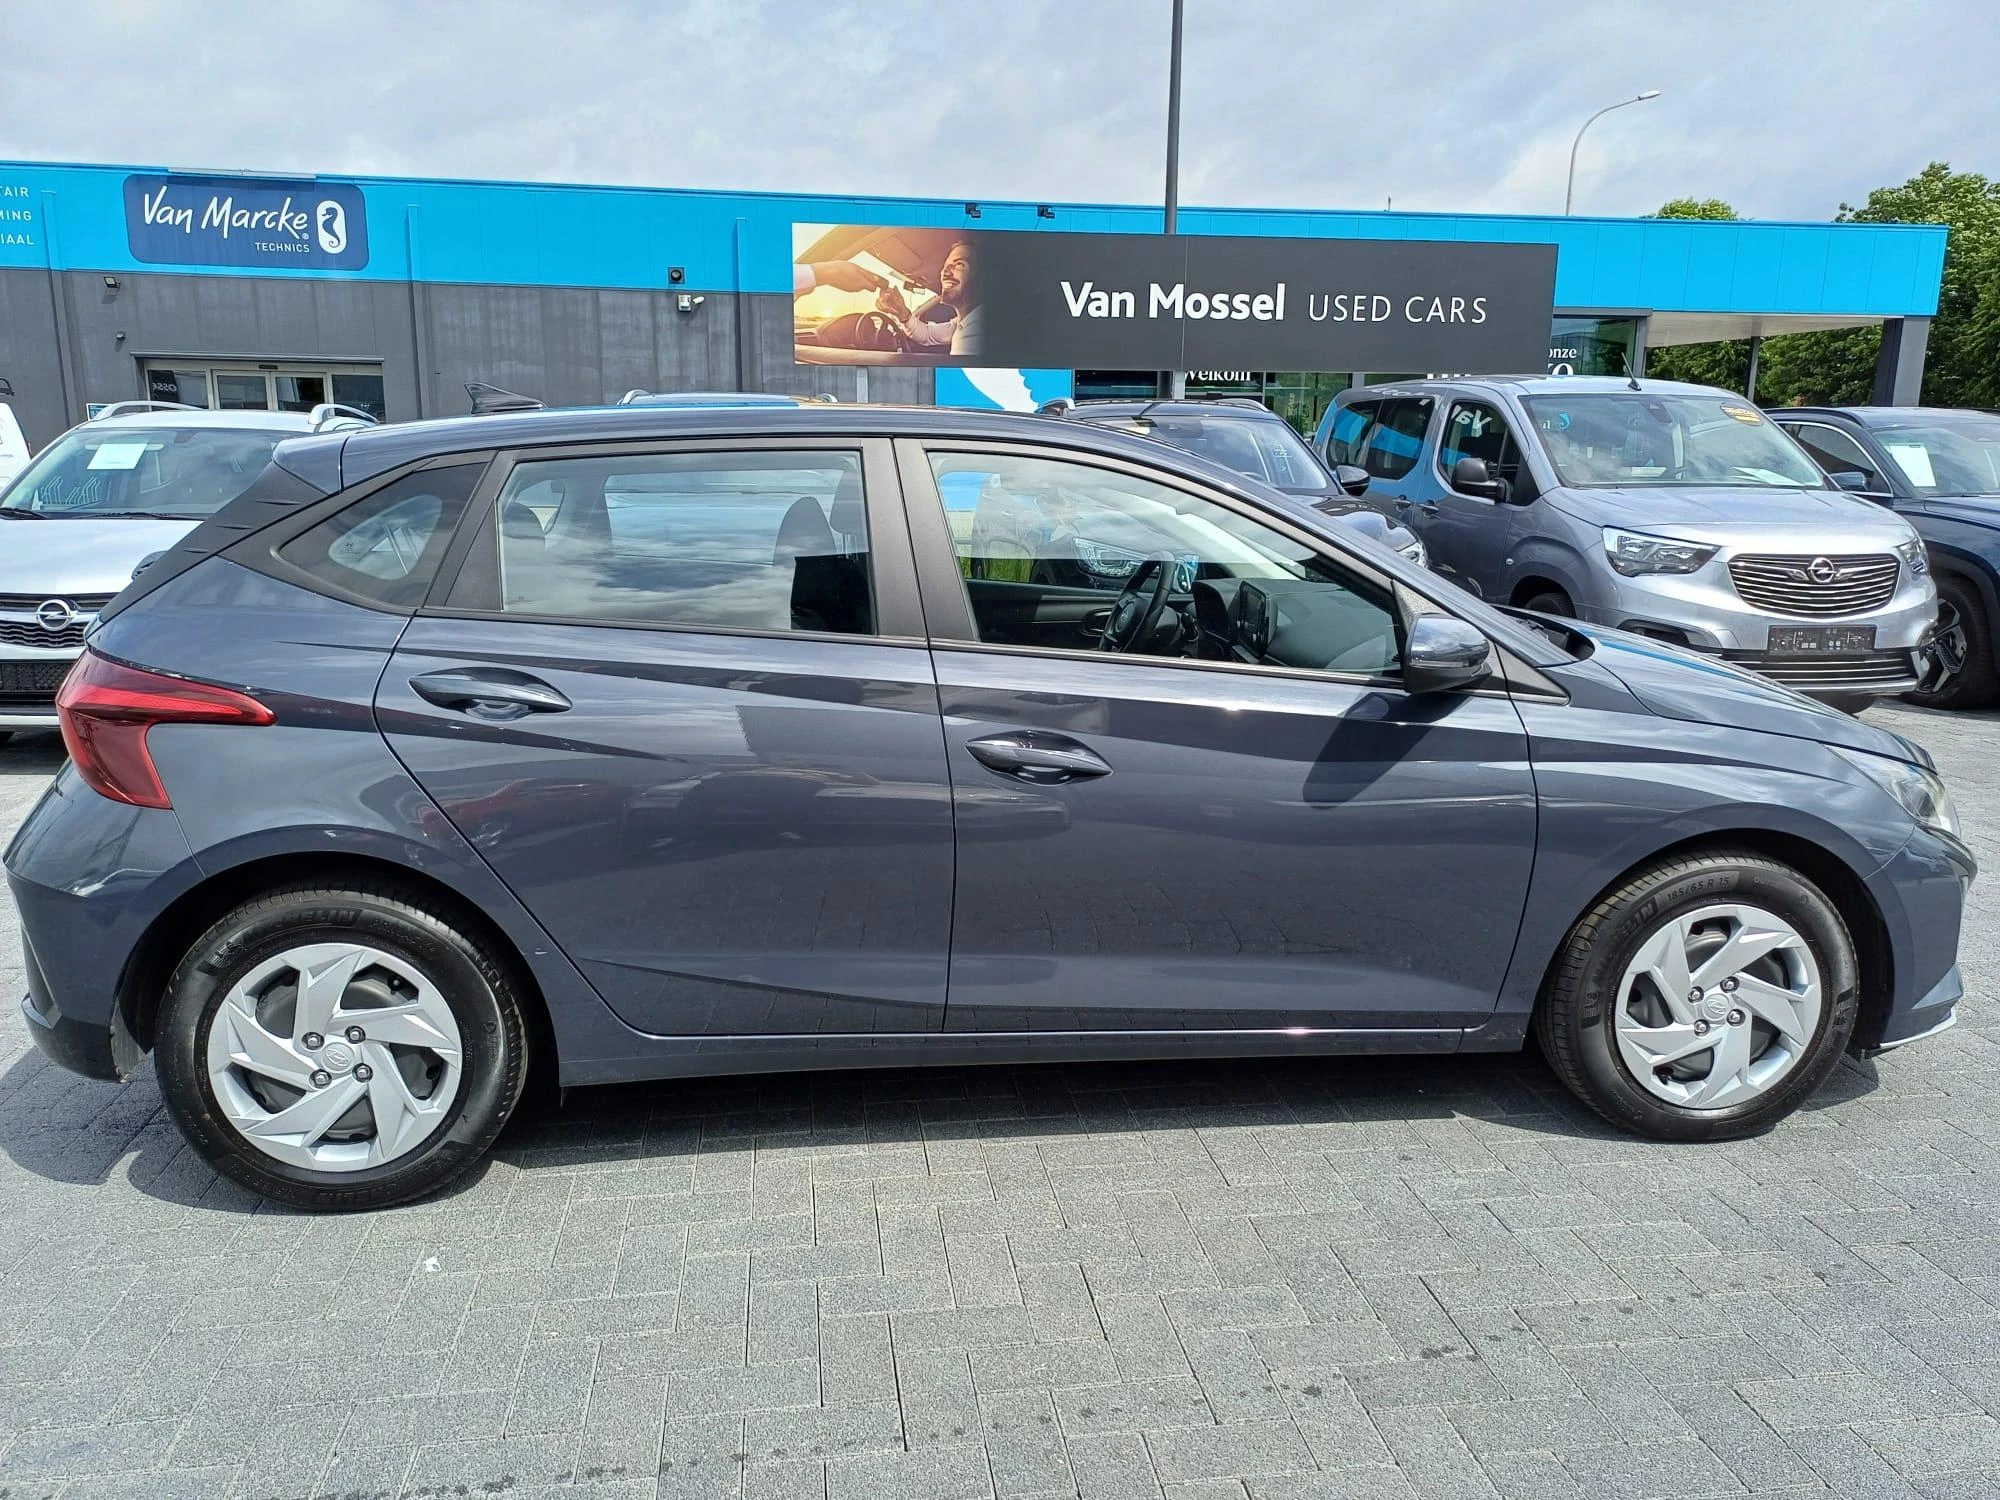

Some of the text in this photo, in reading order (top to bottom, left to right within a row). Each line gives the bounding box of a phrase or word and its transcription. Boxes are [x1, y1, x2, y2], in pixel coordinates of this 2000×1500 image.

[144, 185, 308, 240] Van Marcke
[254, 241, 310, 254] TECHNICS
[1060, 281, 1487, 324] Van Mossel USED CARS
